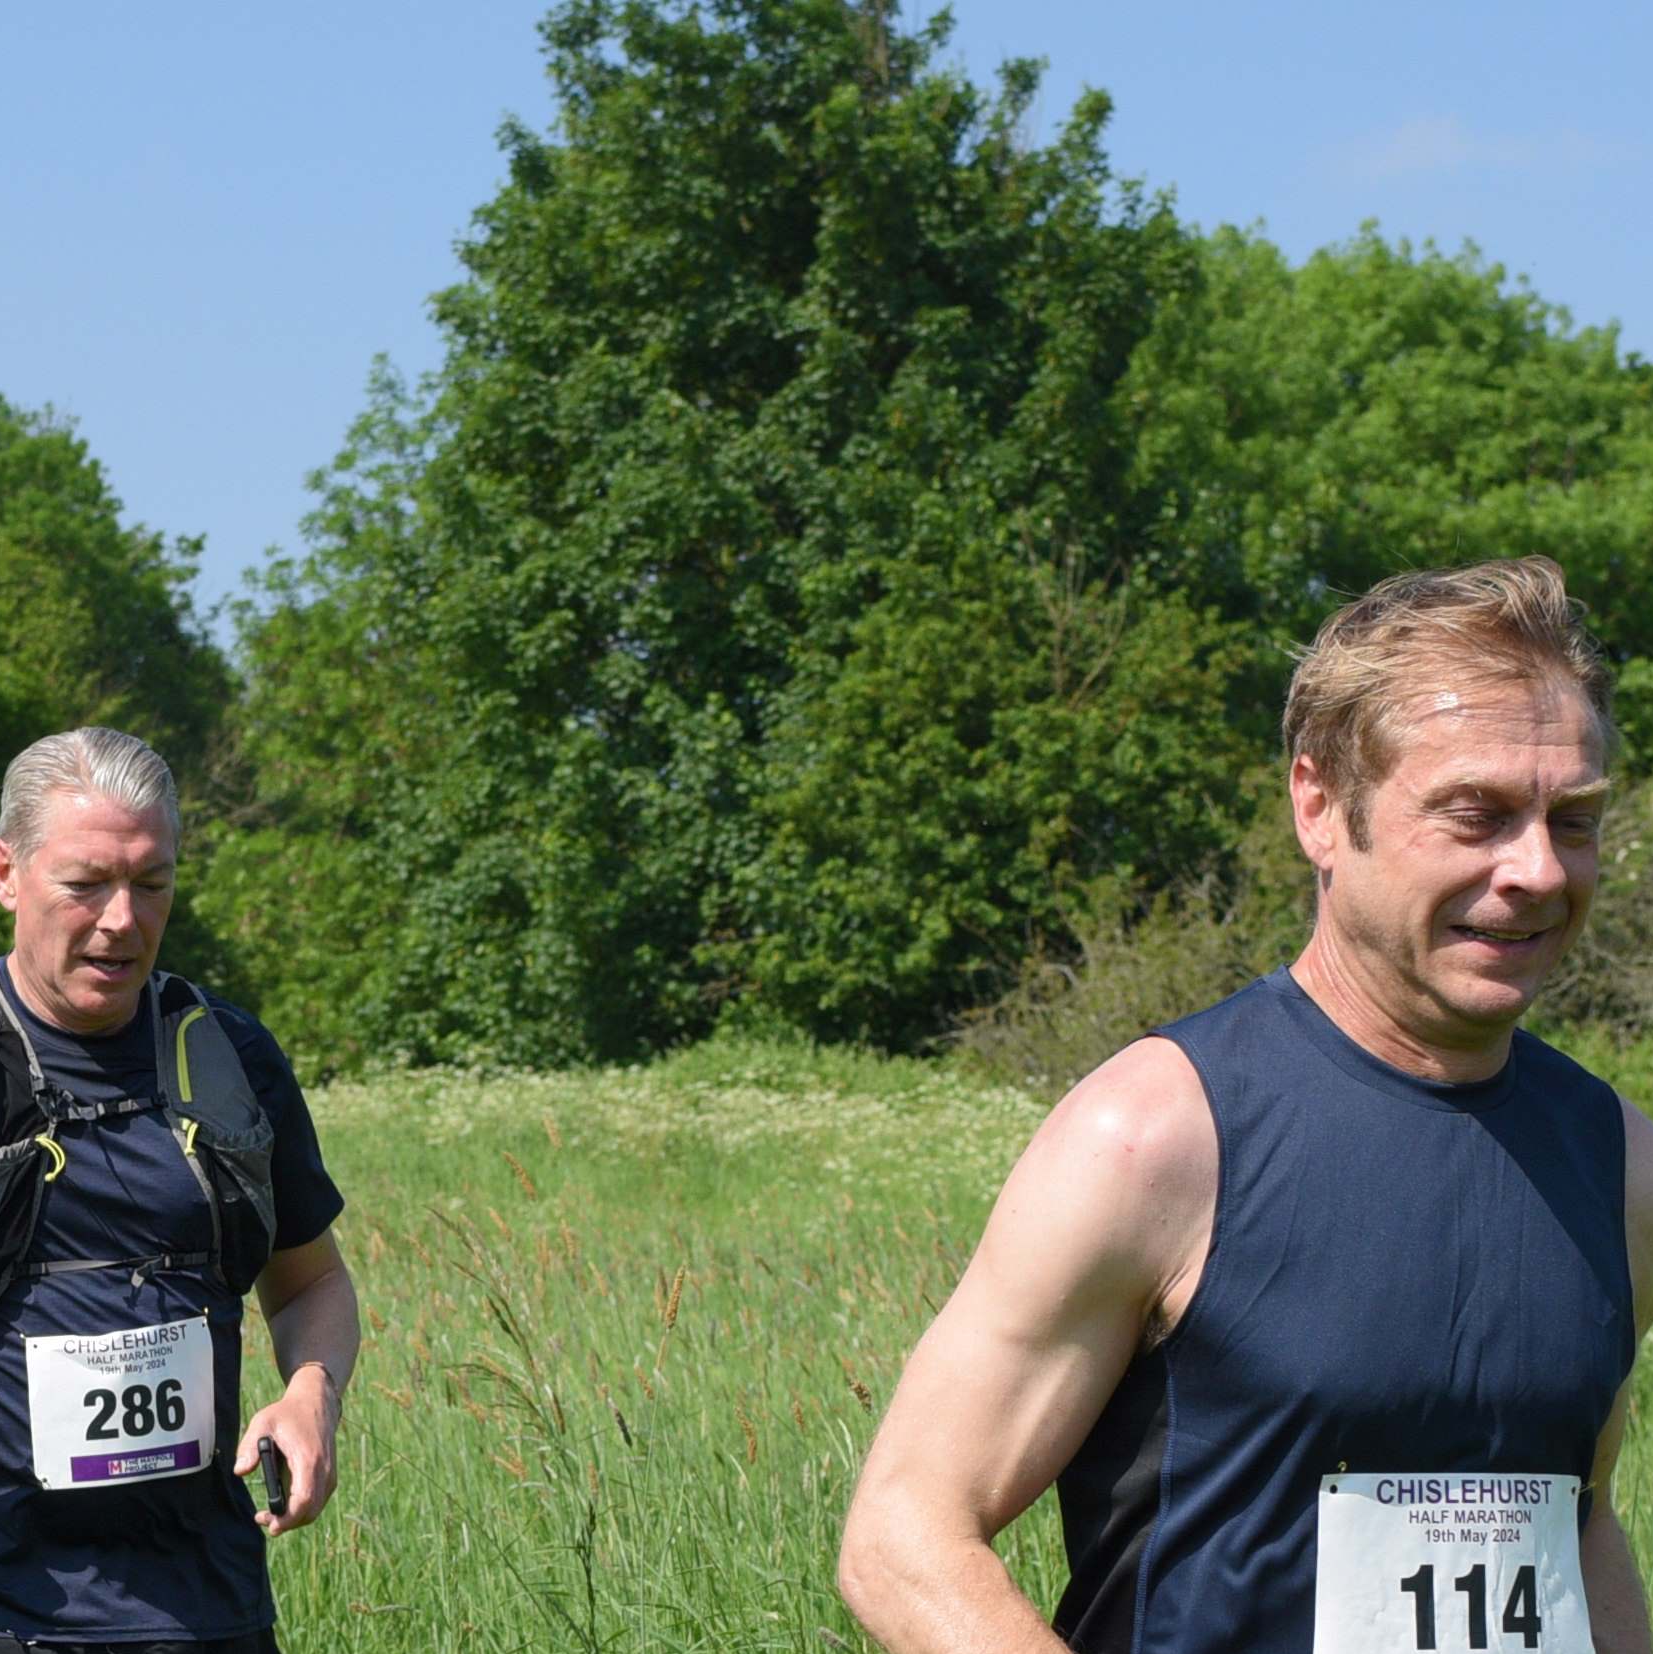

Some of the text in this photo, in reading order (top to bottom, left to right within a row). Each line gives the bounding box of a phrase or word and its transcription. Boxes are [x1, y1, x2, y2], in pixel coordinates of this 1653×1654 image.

[63, 1324, 187, 1354] CHISLEHURST
[87, 1346, 174, 1365] HALF MARATHON
[126, 1363, 144, 1374] May
[146, 1359, 166, 1370] 2024
[83, 1378, 186, 1441] 286
[1376, 1479, 1552, 1505] CHISLEHURST
[1409, 1510, 1532, 1525] HALF MARATHON
[1425, 1529, 1521, 1546] 19th May 2024
[1400, 1564, 1542, 1650] 114
